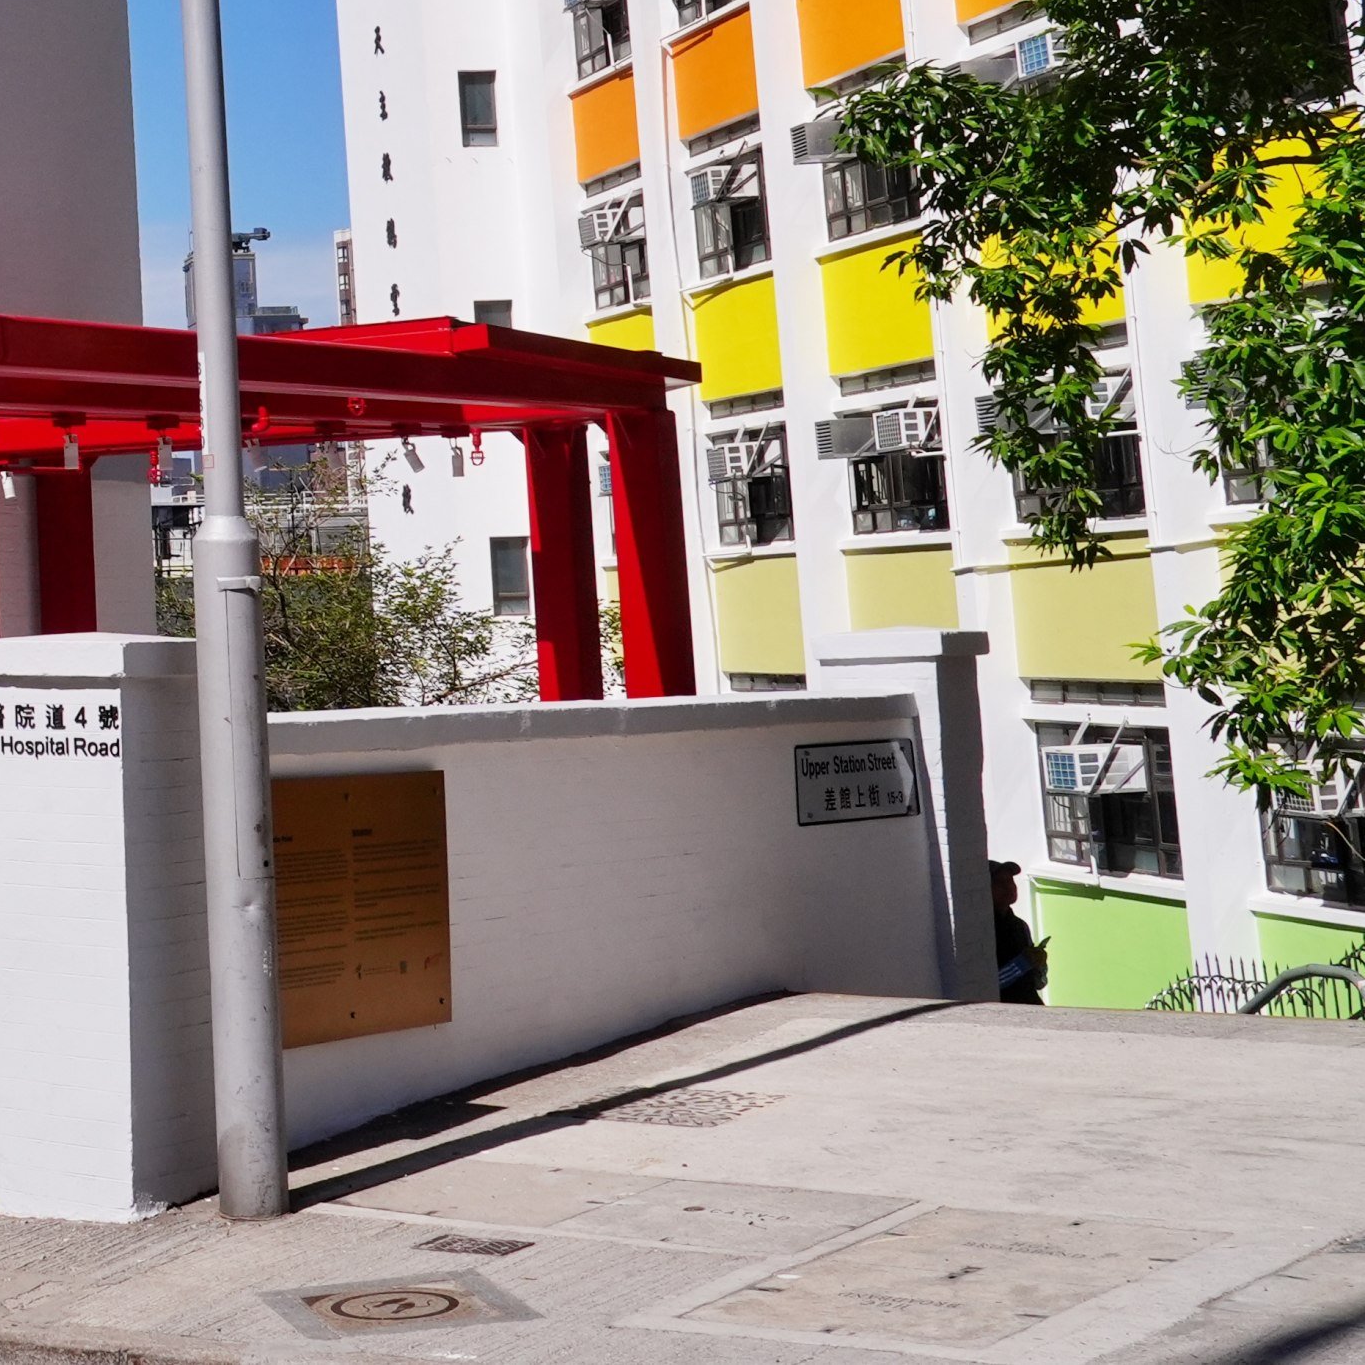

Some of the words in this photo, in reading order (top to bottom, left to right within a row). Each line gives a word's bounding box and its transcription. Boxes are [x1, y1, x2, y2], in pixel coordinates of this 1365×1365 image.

[1, 736, 69, 760] Hospital
[74, 738, 120, 758] Road
[801, 758, 829, 779] Upper
[833, 754, 866, 775] Station
[867, 752, 896, 772] Street
[824, 784, 880, 811] 差館上街
[887, 791, 904, 804] 15-3
